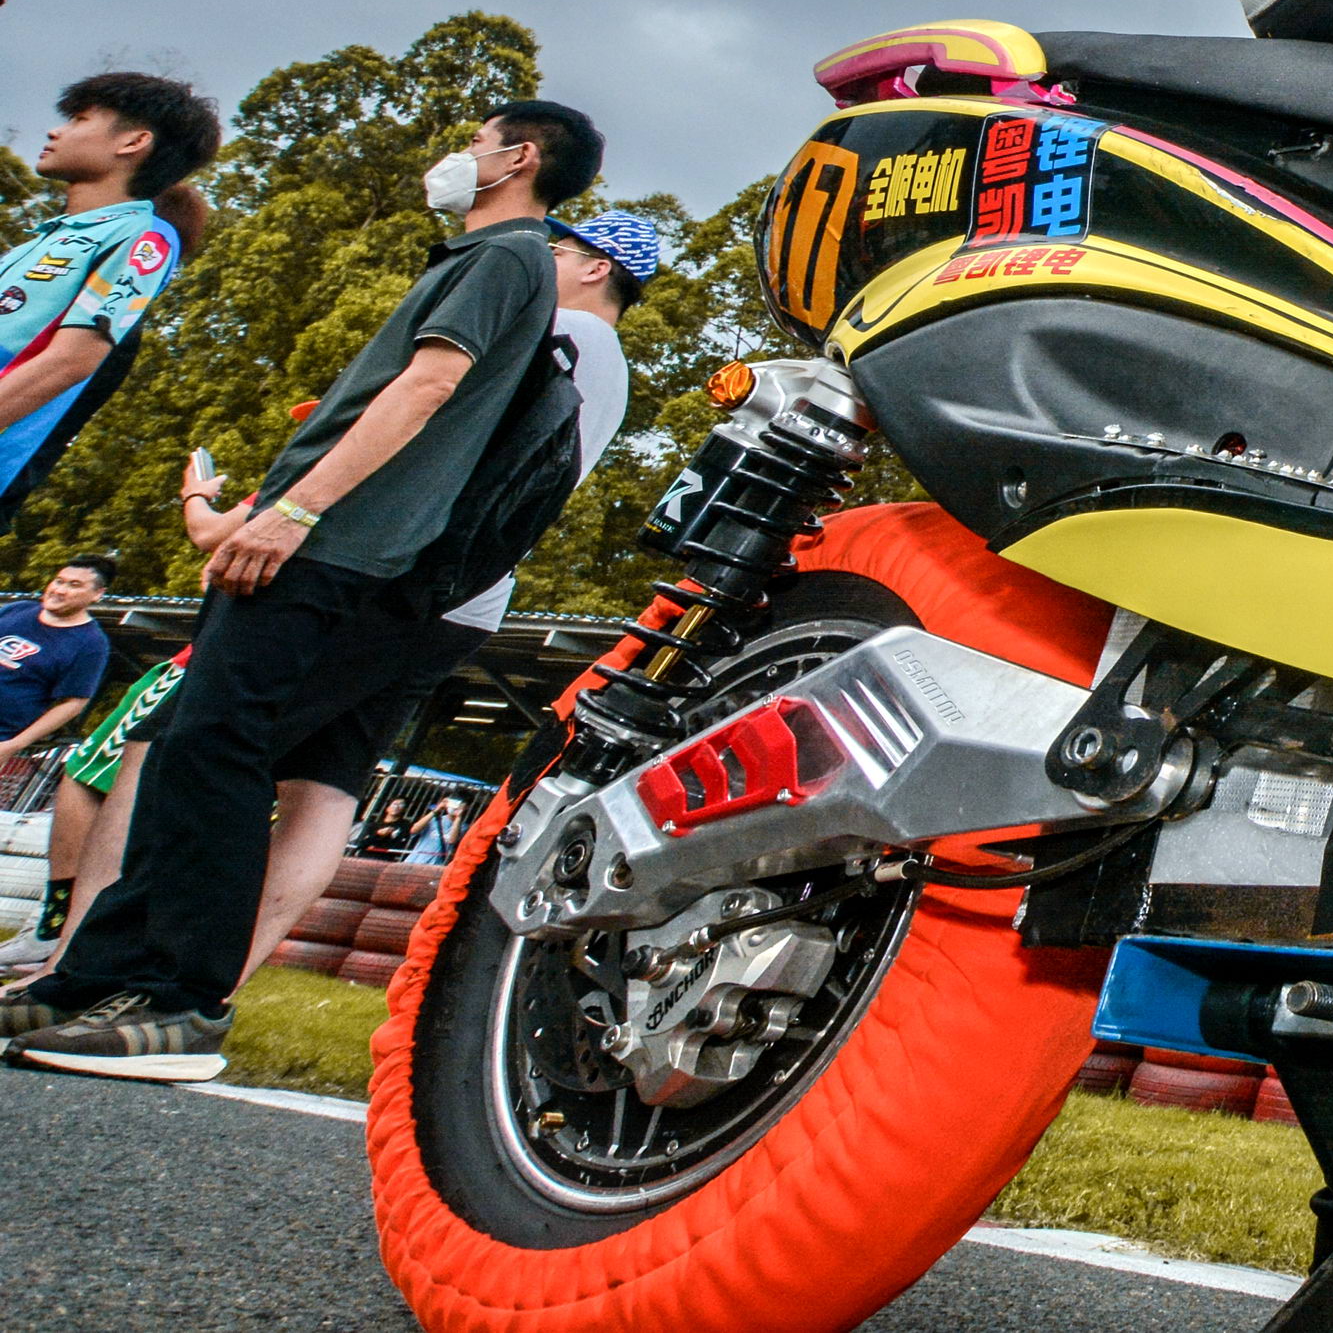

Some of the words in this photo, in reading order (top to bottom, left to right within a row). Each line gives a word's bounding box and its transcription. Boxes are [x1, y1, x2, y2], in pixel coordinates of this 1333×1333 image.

[863, 147, 967, 221] 全顺电机
[933, 248, 1088, 286] 粤凯锂电
